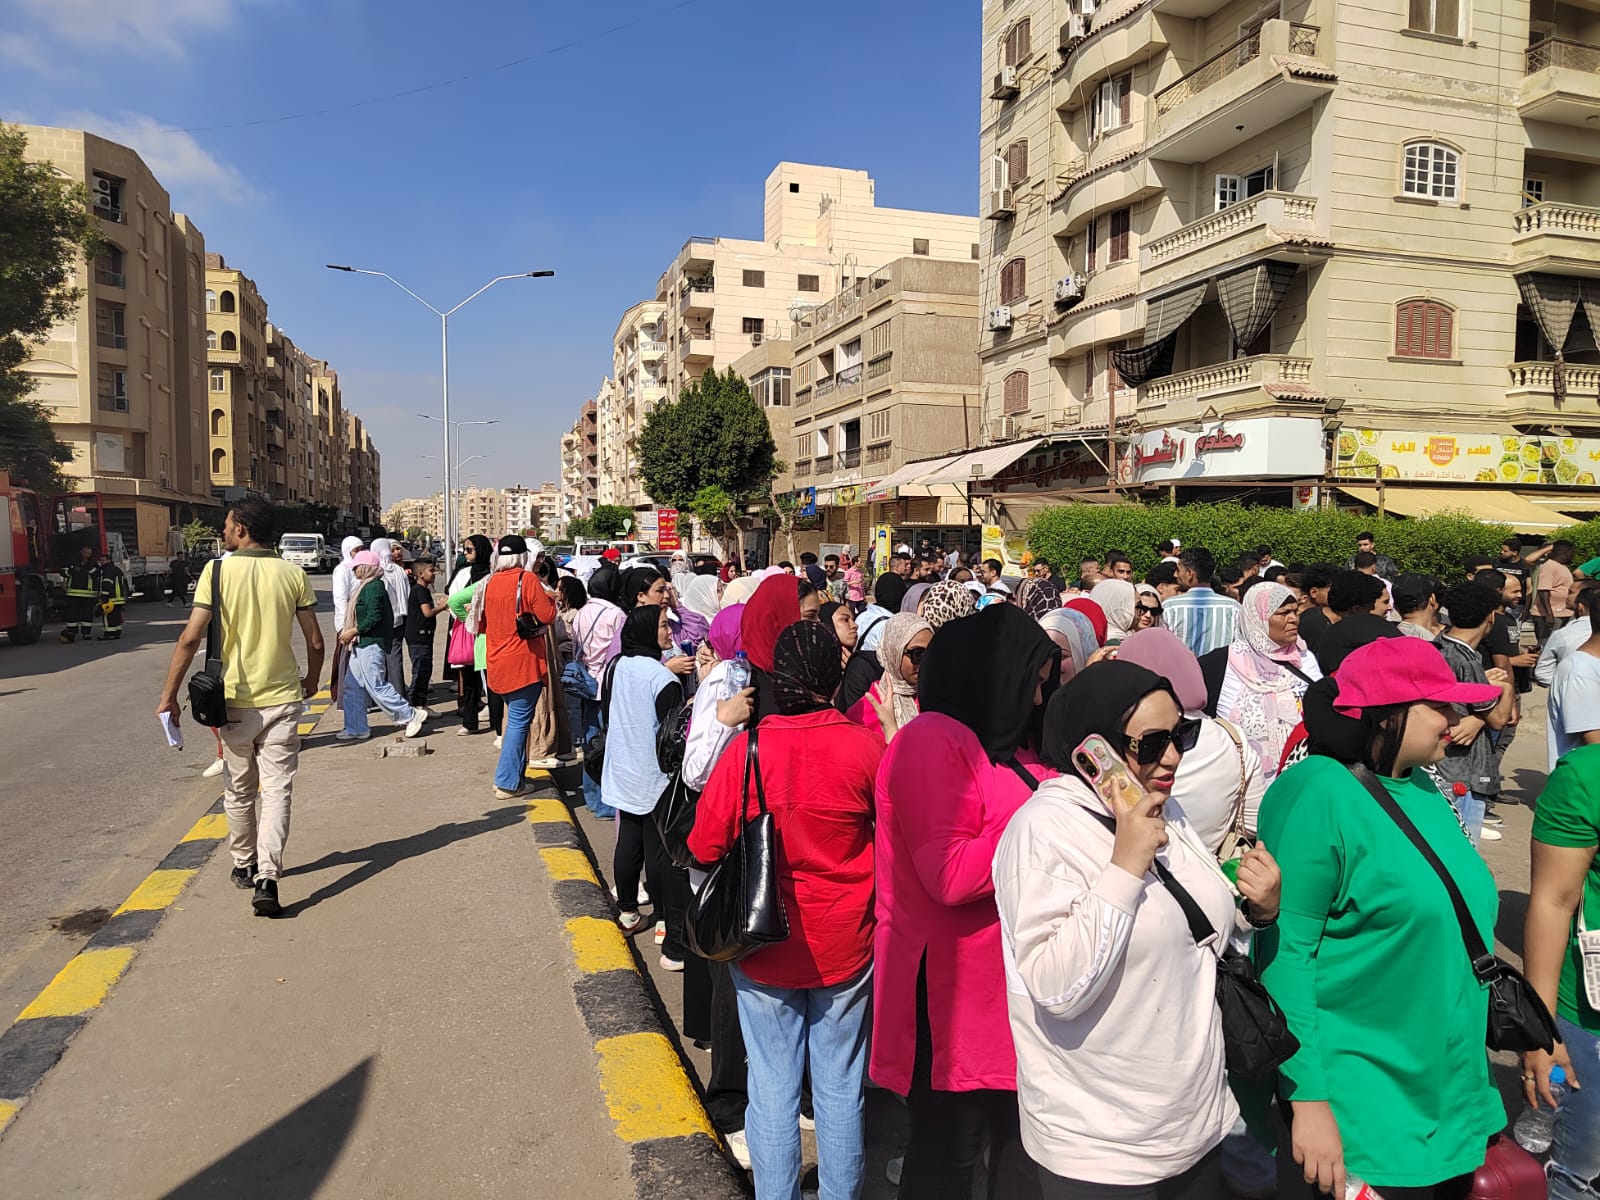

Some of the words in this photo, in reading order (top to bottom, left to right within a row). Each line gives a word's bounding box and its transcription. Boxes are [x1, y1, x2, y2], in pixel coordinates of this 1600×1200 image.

[1195, 428, 1242, 459] مطعم
[1391, 441, 1416, 454] اللذيذ
[1467, 444, 1491, 457] الطعم
